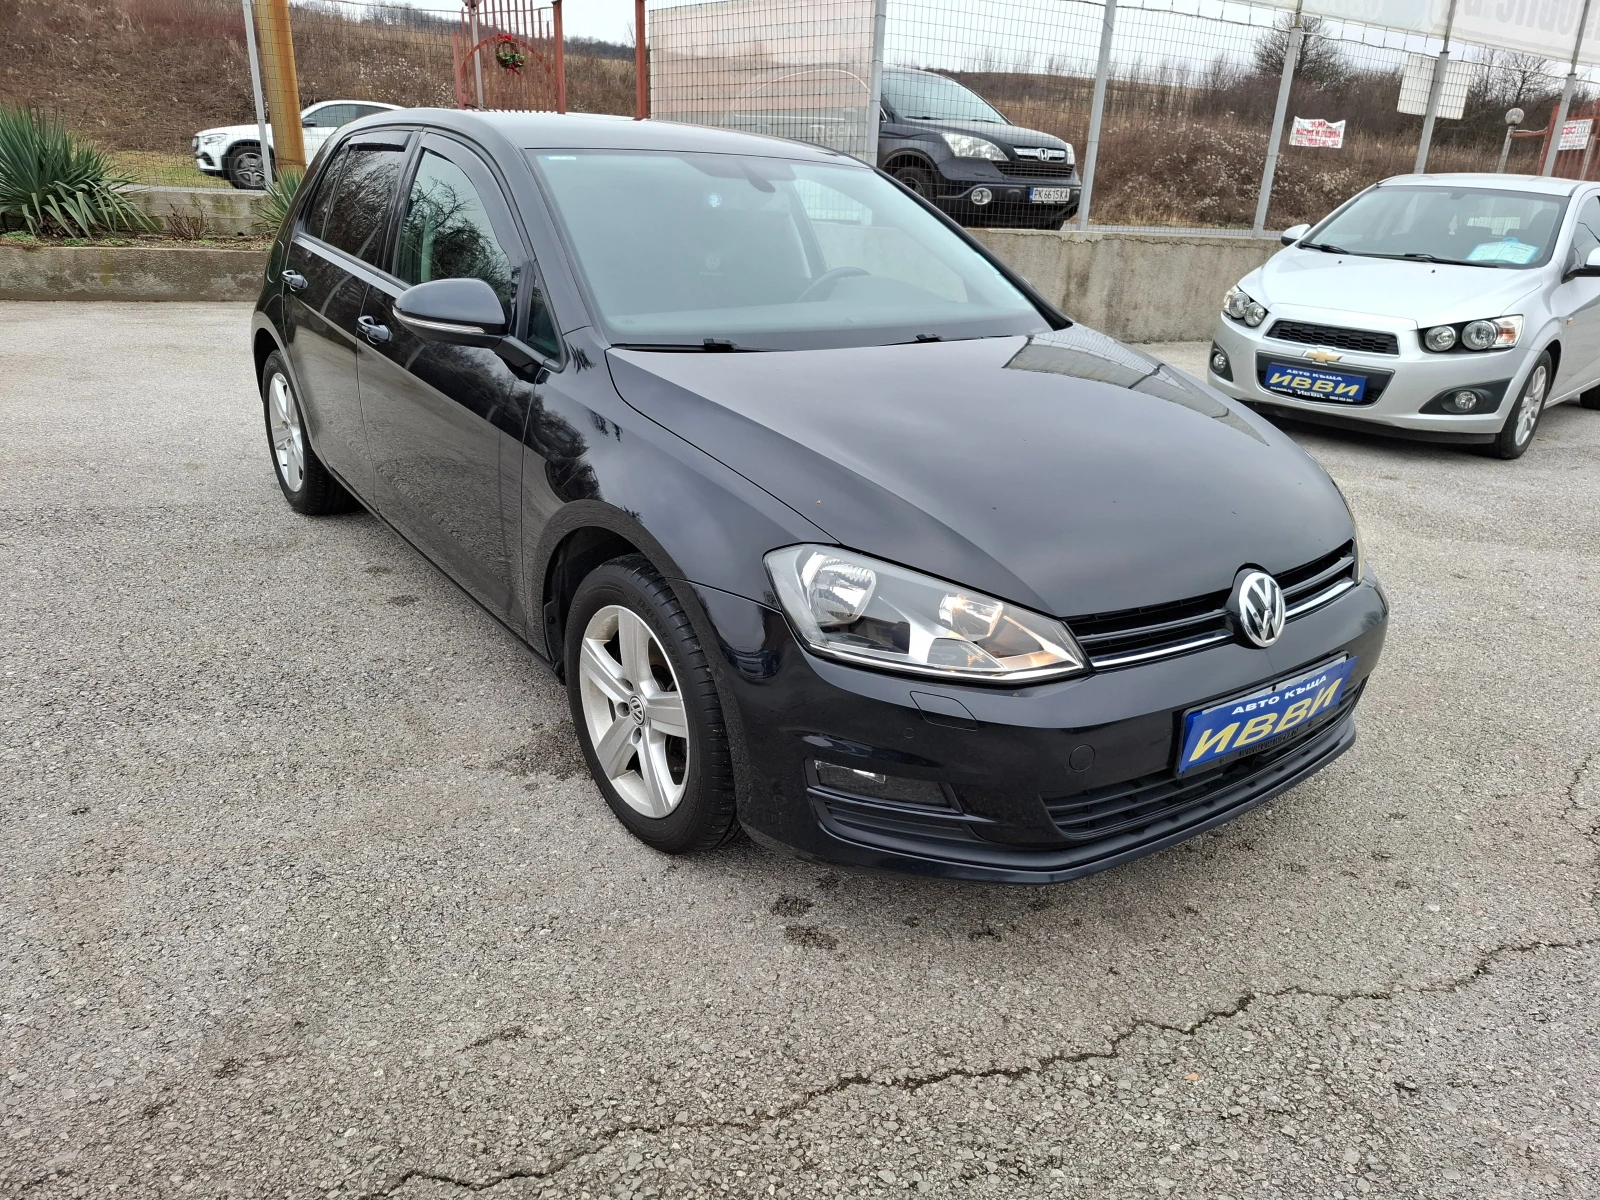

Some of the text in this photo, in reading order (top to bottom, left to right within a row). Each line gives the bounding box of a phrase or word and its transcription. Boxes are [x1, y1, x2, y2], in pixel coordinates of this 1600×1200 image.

[1269, 372, 1360, 396] ИВВИ
[1286, 368, 1343, 381] АВТО КЪЩА
[1231, 675, 1327, 715] АВТО КЪЩА
[1189, 677, 1343, 762] ИВВИ
